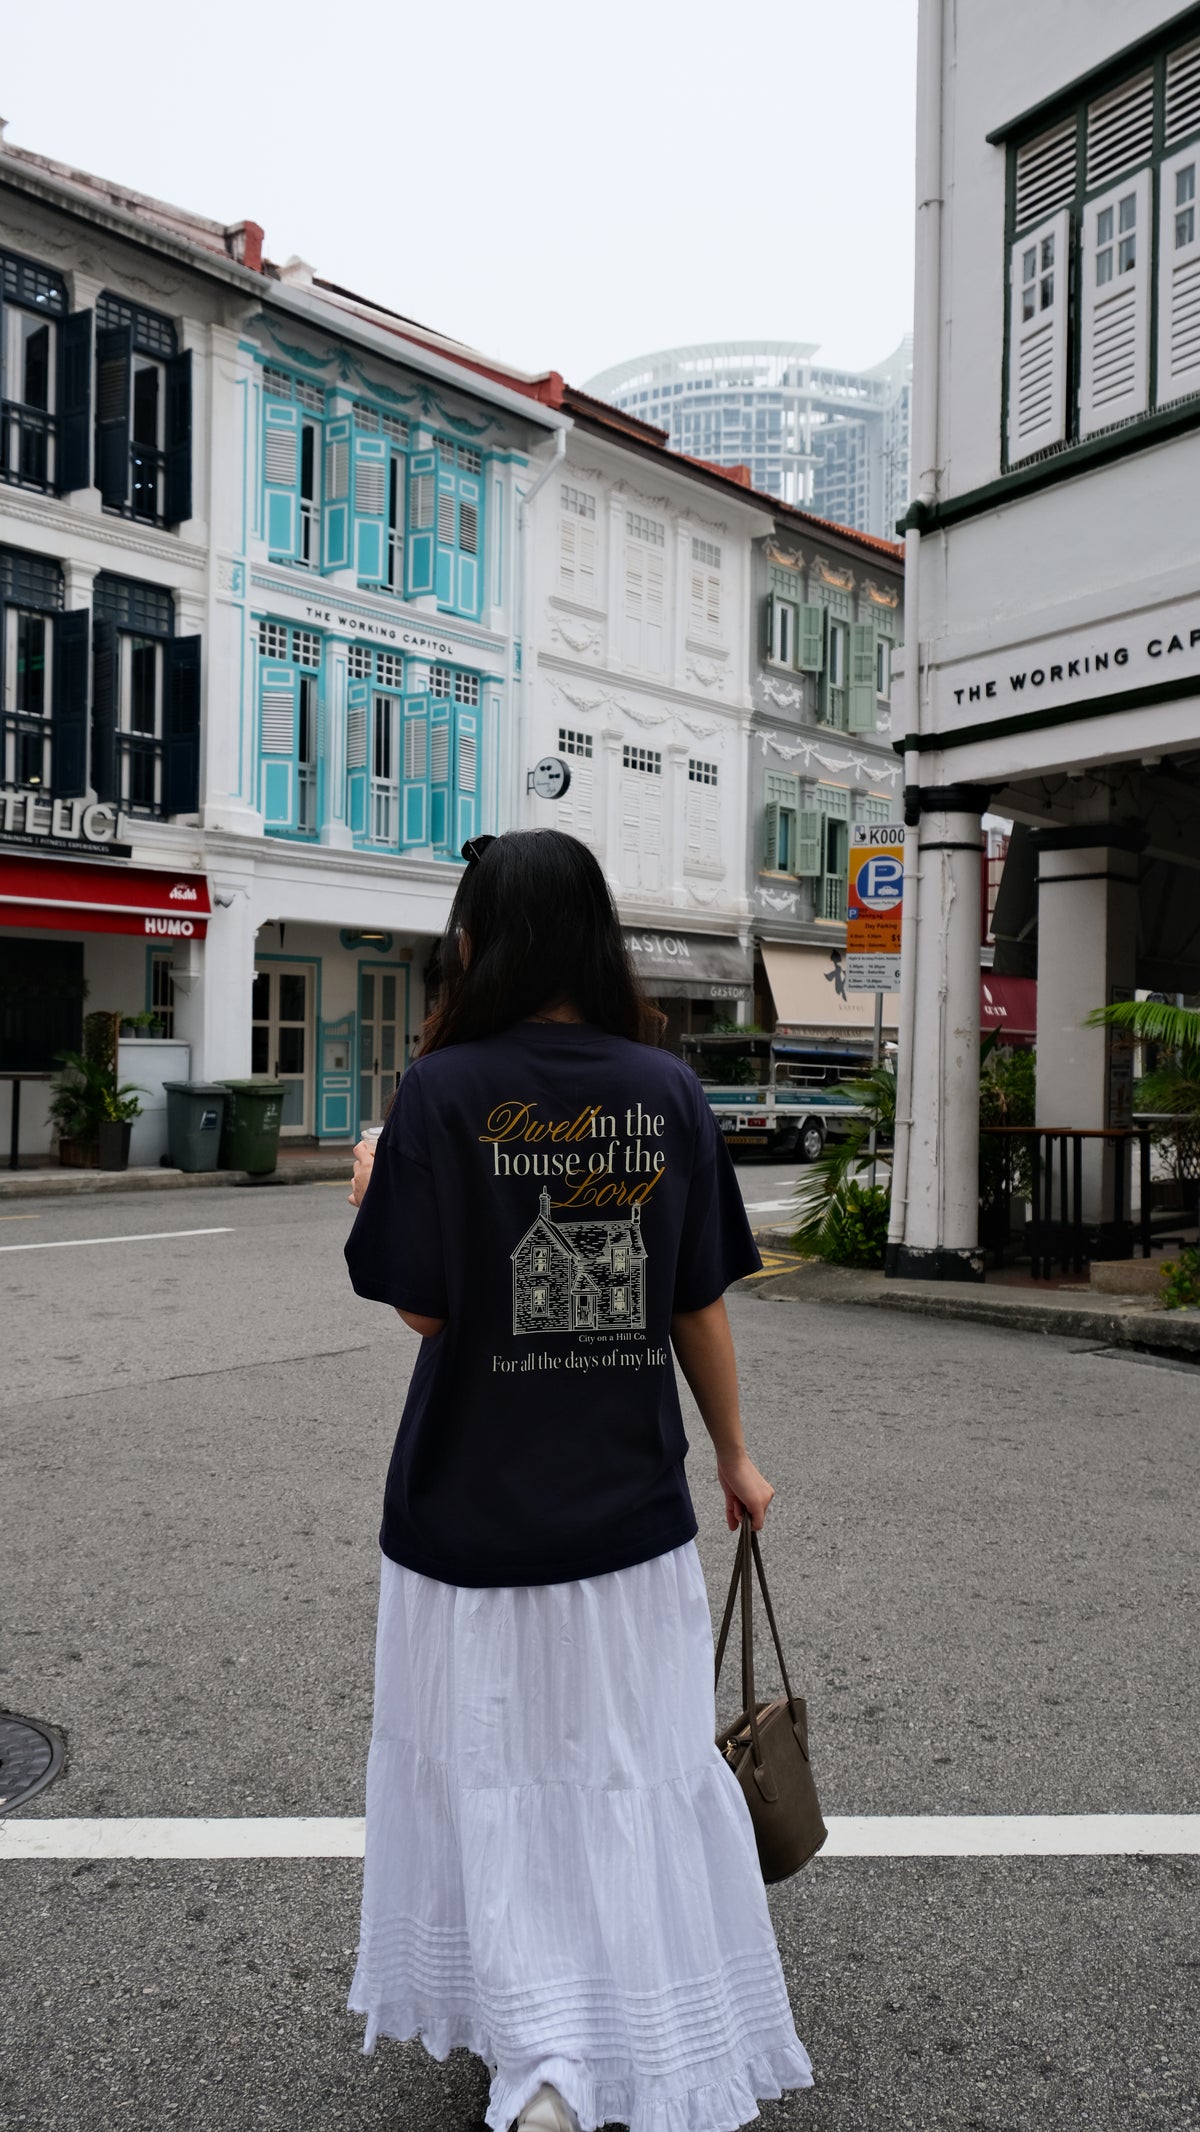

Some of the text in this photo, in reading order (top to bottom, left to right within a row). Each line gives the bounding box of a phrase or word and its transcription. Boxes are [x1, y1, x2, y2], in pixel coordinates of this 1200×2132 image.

[306, 607, 453, 655] THE WORKING CAPITOL
[953, 681, 997, 705] THE
[1010, 648, 1129, 691] WORKING
[169, 887, 198, 901] Asahi
[867, 860, 903, 897] P
[145, 917, 194, 936] HUMO
[478, 1101, 665, 1143] Dwell in the
[492, 1139, 665, 1176] house of the
[550, 1163, 666, 1209] Lord
[578, 1334, 595, 1344] City
[616, 1332, 632, 1341] Hill
[633, 1332, 647, 1341] Co.
[492, 1347, 667, 1373] For all the days of my life
